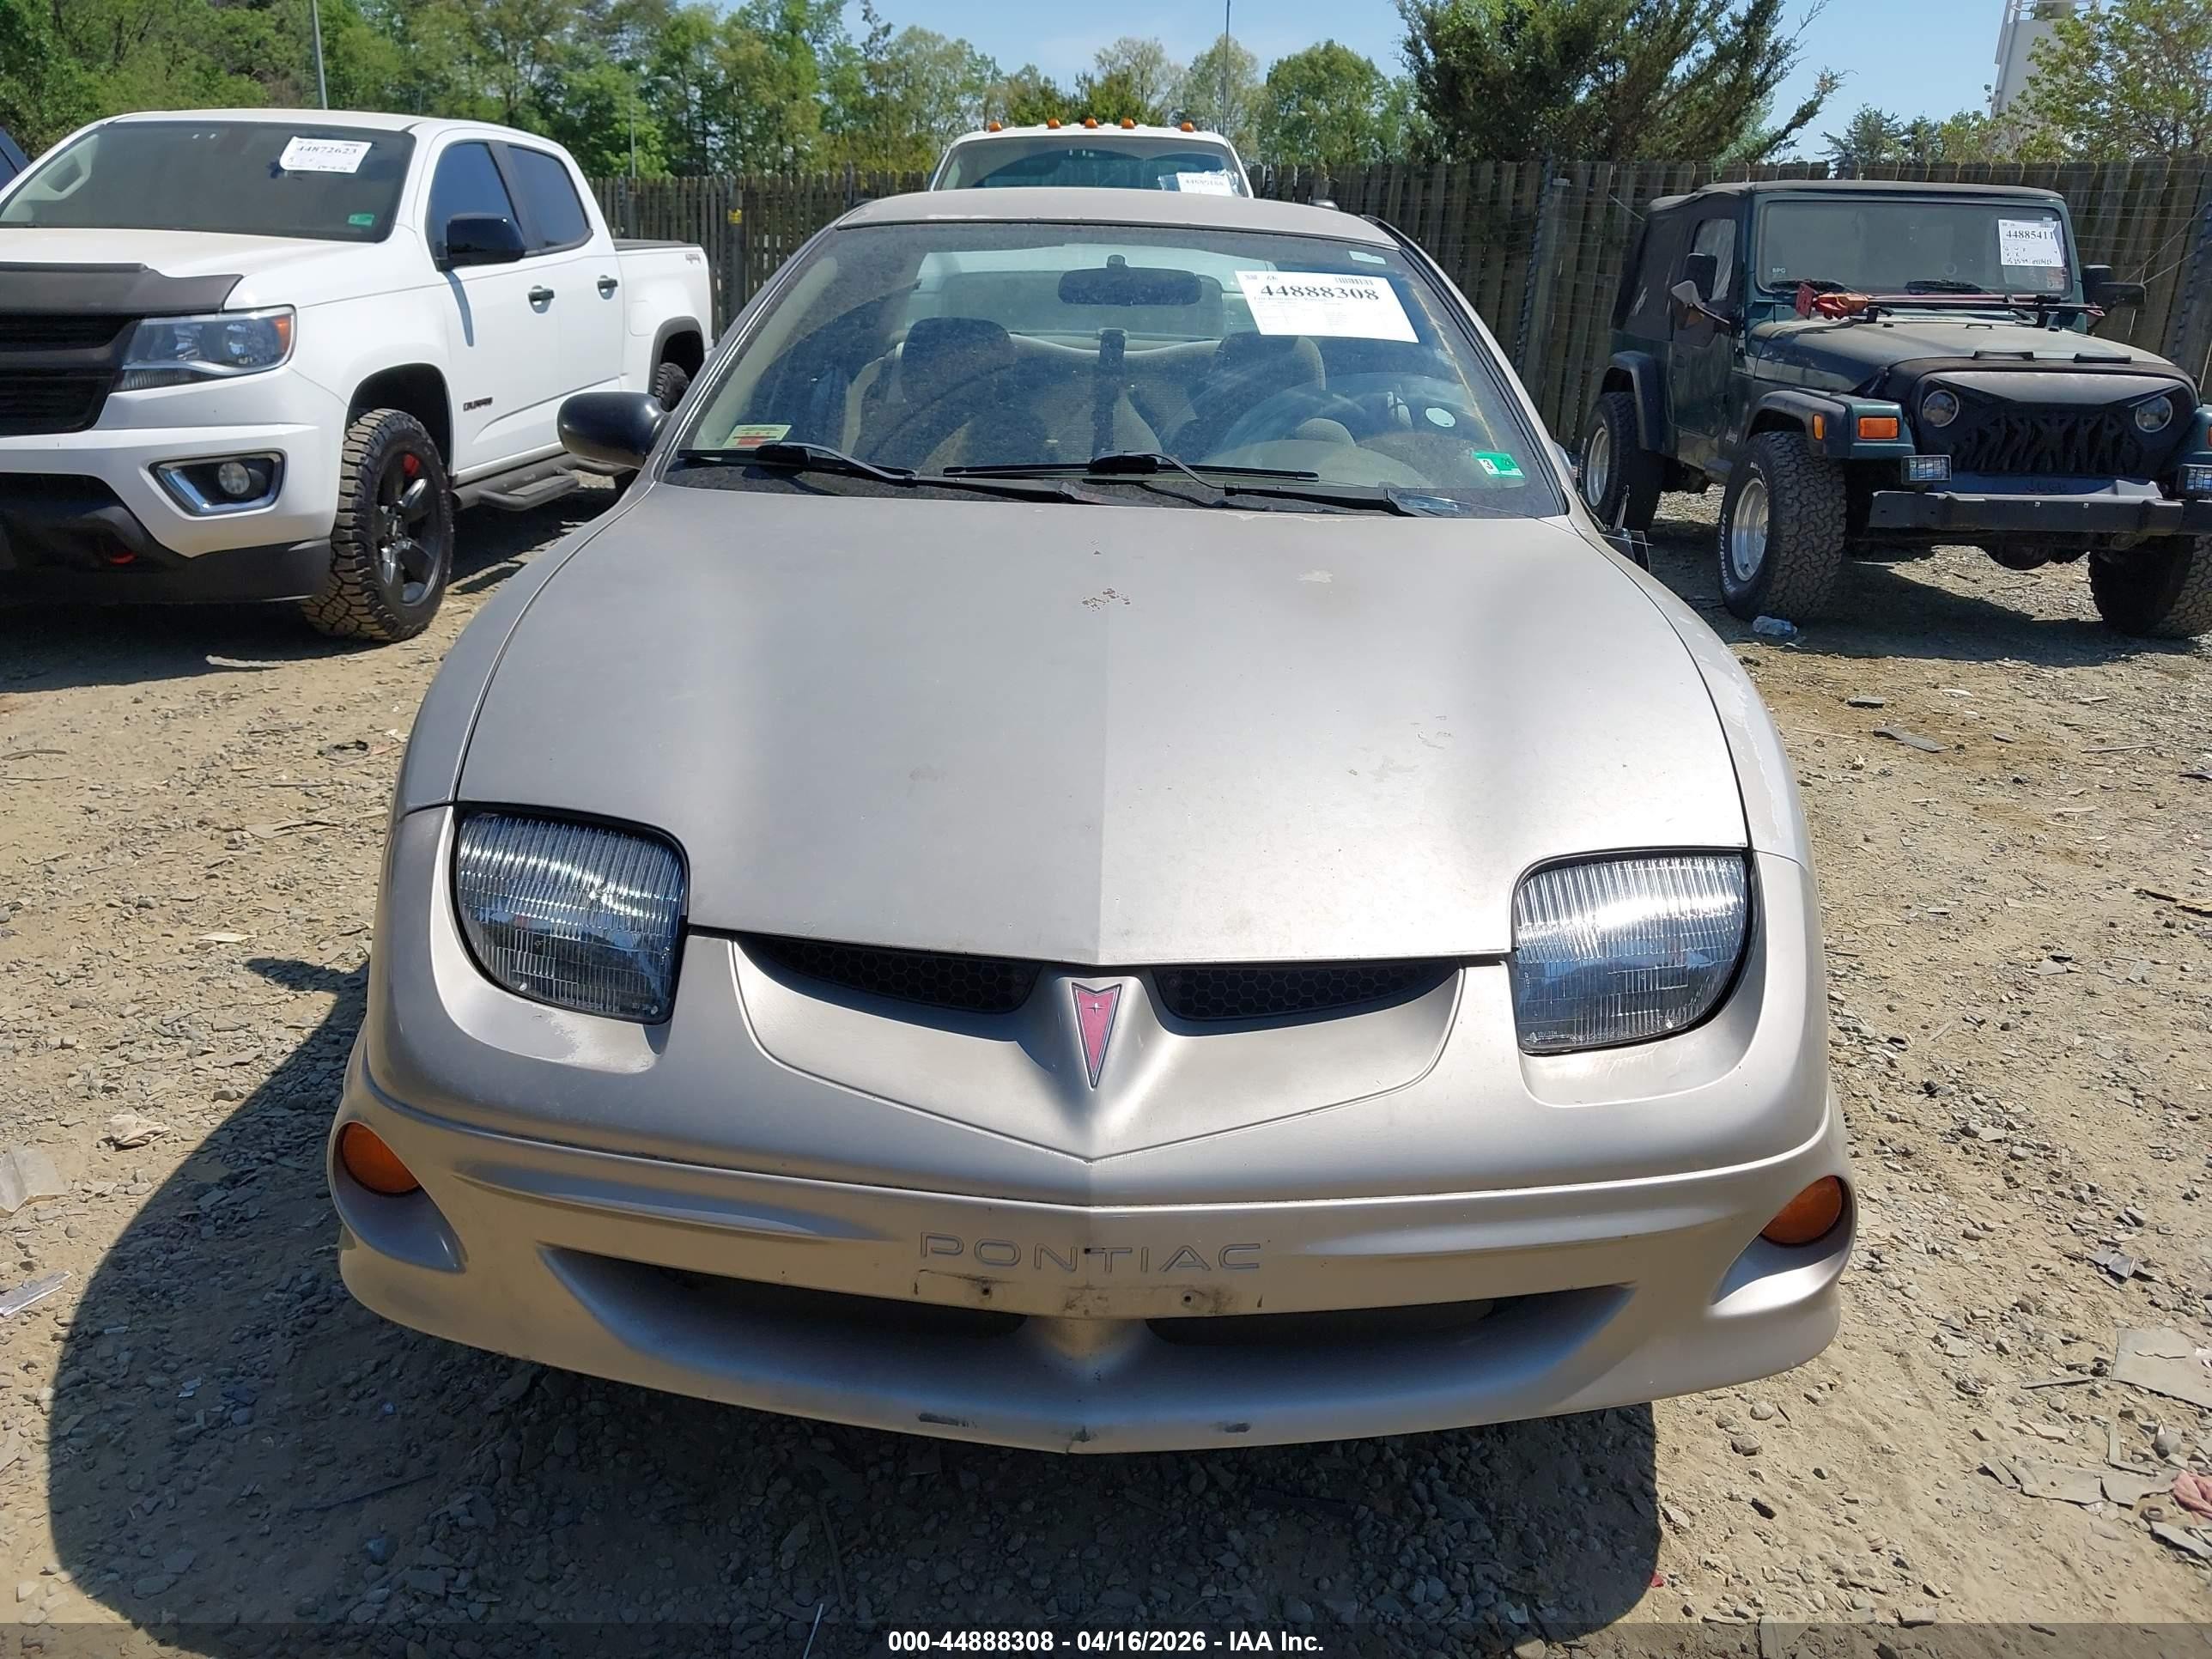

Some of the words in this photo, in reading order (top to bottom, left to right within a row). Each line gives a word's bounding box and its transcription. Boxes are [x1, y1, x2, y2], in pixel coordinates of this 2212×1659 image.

[2006, 229, 2054, 240] 44885411
[1260, 284, 1380, 301] 44888308
[919, 1231, 1262, 1274] PONTIAC
